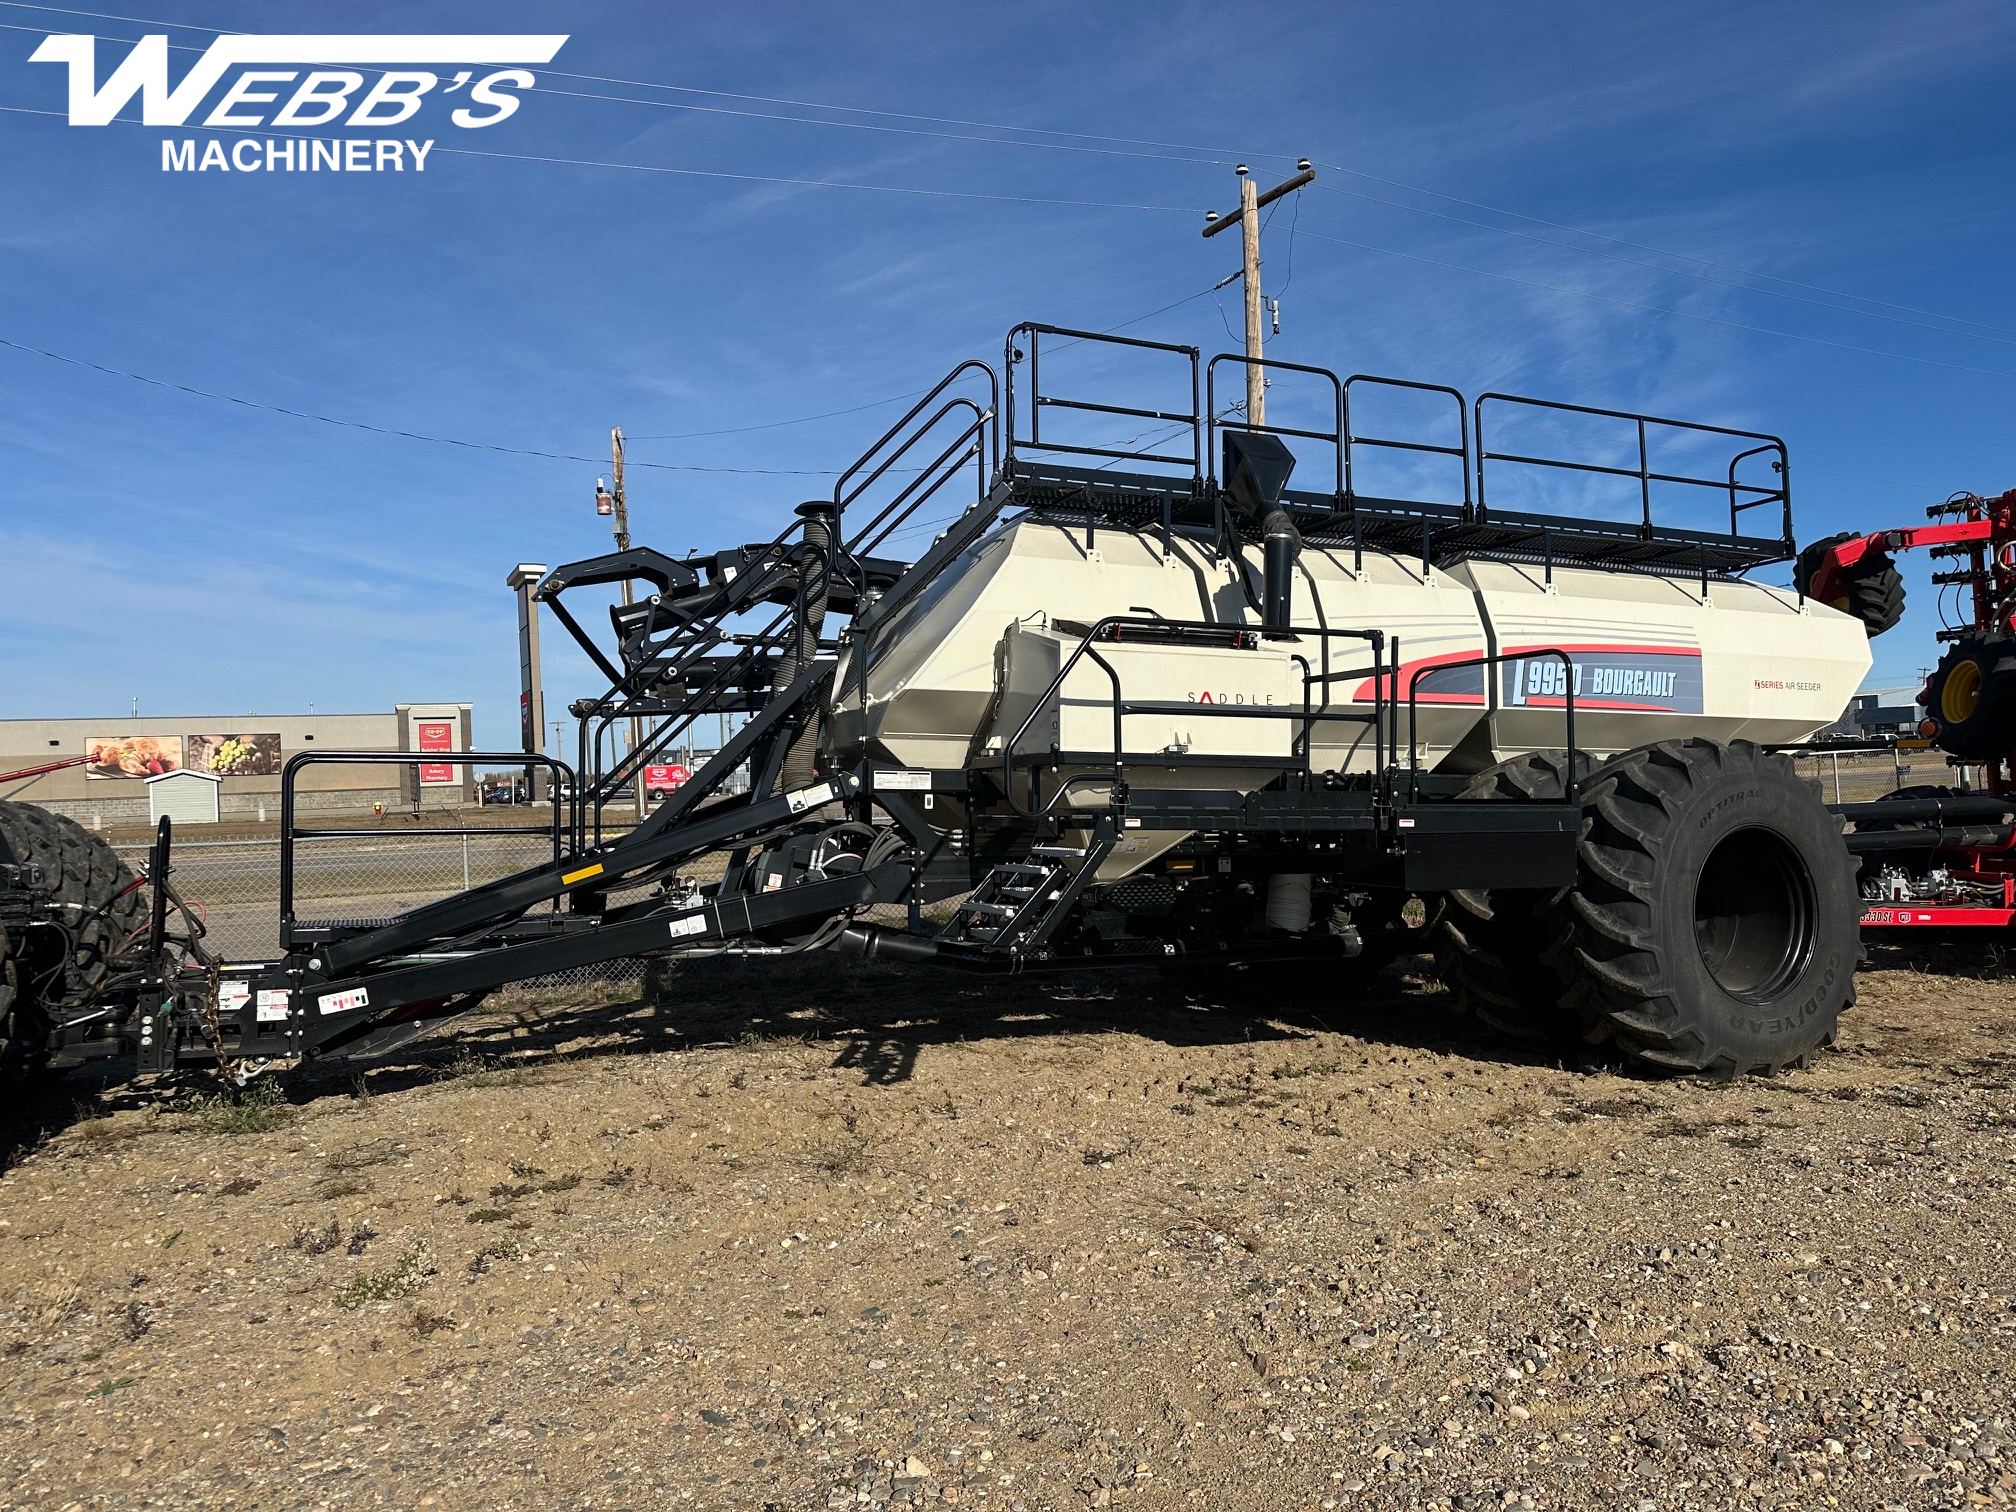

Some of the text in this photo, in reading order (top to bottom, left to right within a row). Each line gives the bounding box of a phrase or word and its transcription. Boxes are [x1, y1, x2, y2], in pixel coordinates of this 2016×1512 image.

[1592, 668, 1677, 697] BOURGAULT
[1760, 680, 1784, 690] SERIES
[1785, 682, 1795, 690] AIR
[1796, 682, 1821, 691] SEEDER
[1187, 691, 1273, 706] SADDLE
[1700, 787, 1764, 829] OPTITRAC
[1729, 950, 1840, 1035] GOODYEAR
